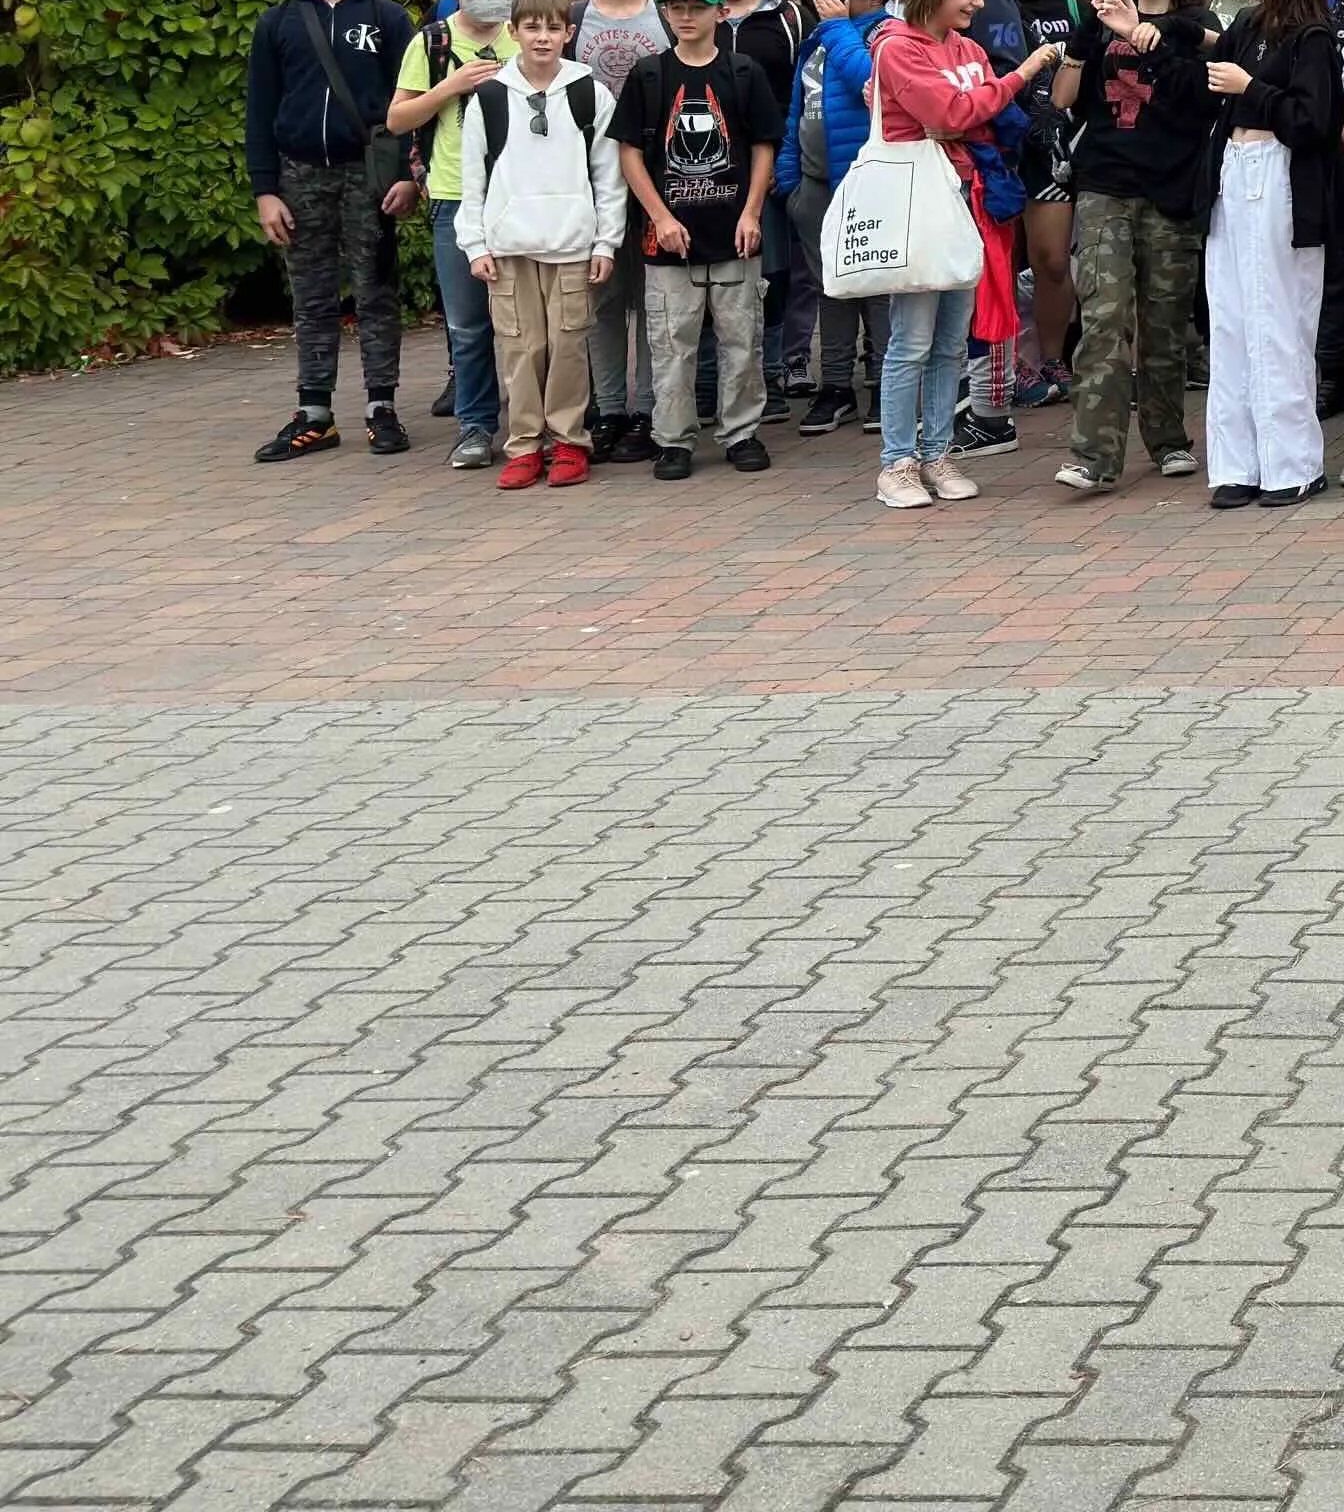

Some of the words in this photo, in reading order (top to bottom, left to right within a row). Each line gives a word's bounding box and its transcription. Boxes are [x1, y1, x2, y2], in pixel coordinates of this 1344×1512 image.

[988, 22, 1019, 48] 76
[665, 184, 739, 204] FURIOUS
[847, 207, 857, 222] #
[846, 219, 883, 235] wear
[844, 234, 869, 250] the
[843, 248, 899, 266] change
